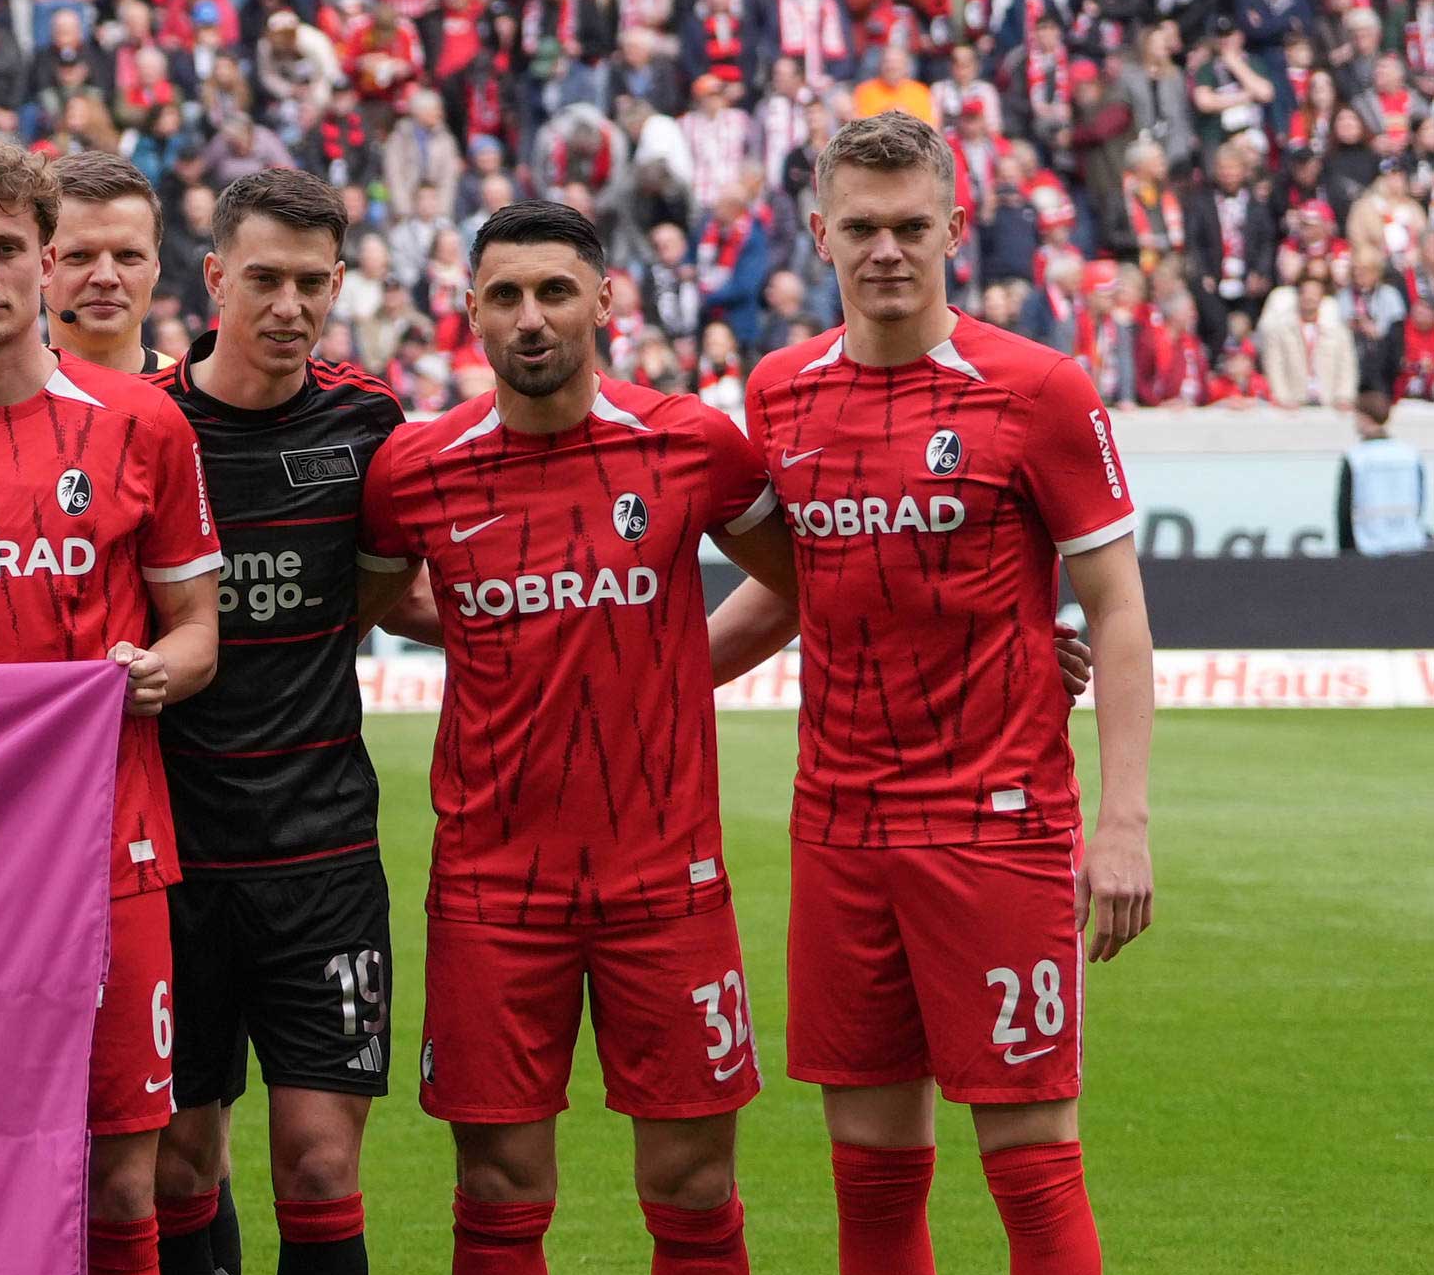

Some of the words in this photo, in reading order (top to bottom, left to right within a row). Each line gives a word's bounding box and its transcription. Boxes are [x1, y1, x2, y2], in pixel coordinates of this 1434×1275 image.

[1089, 408, 1122, 500] Lexware
[791, 494, 966, 538] JOBRAD
[452, 566, 659, 617] JOBRAD
[151, 979, 173, 1060] 6
[324, 949, 386, 1036] 19
[691, 968, 750, 1061] 32
[985, 959, 1065, 1045] 28
